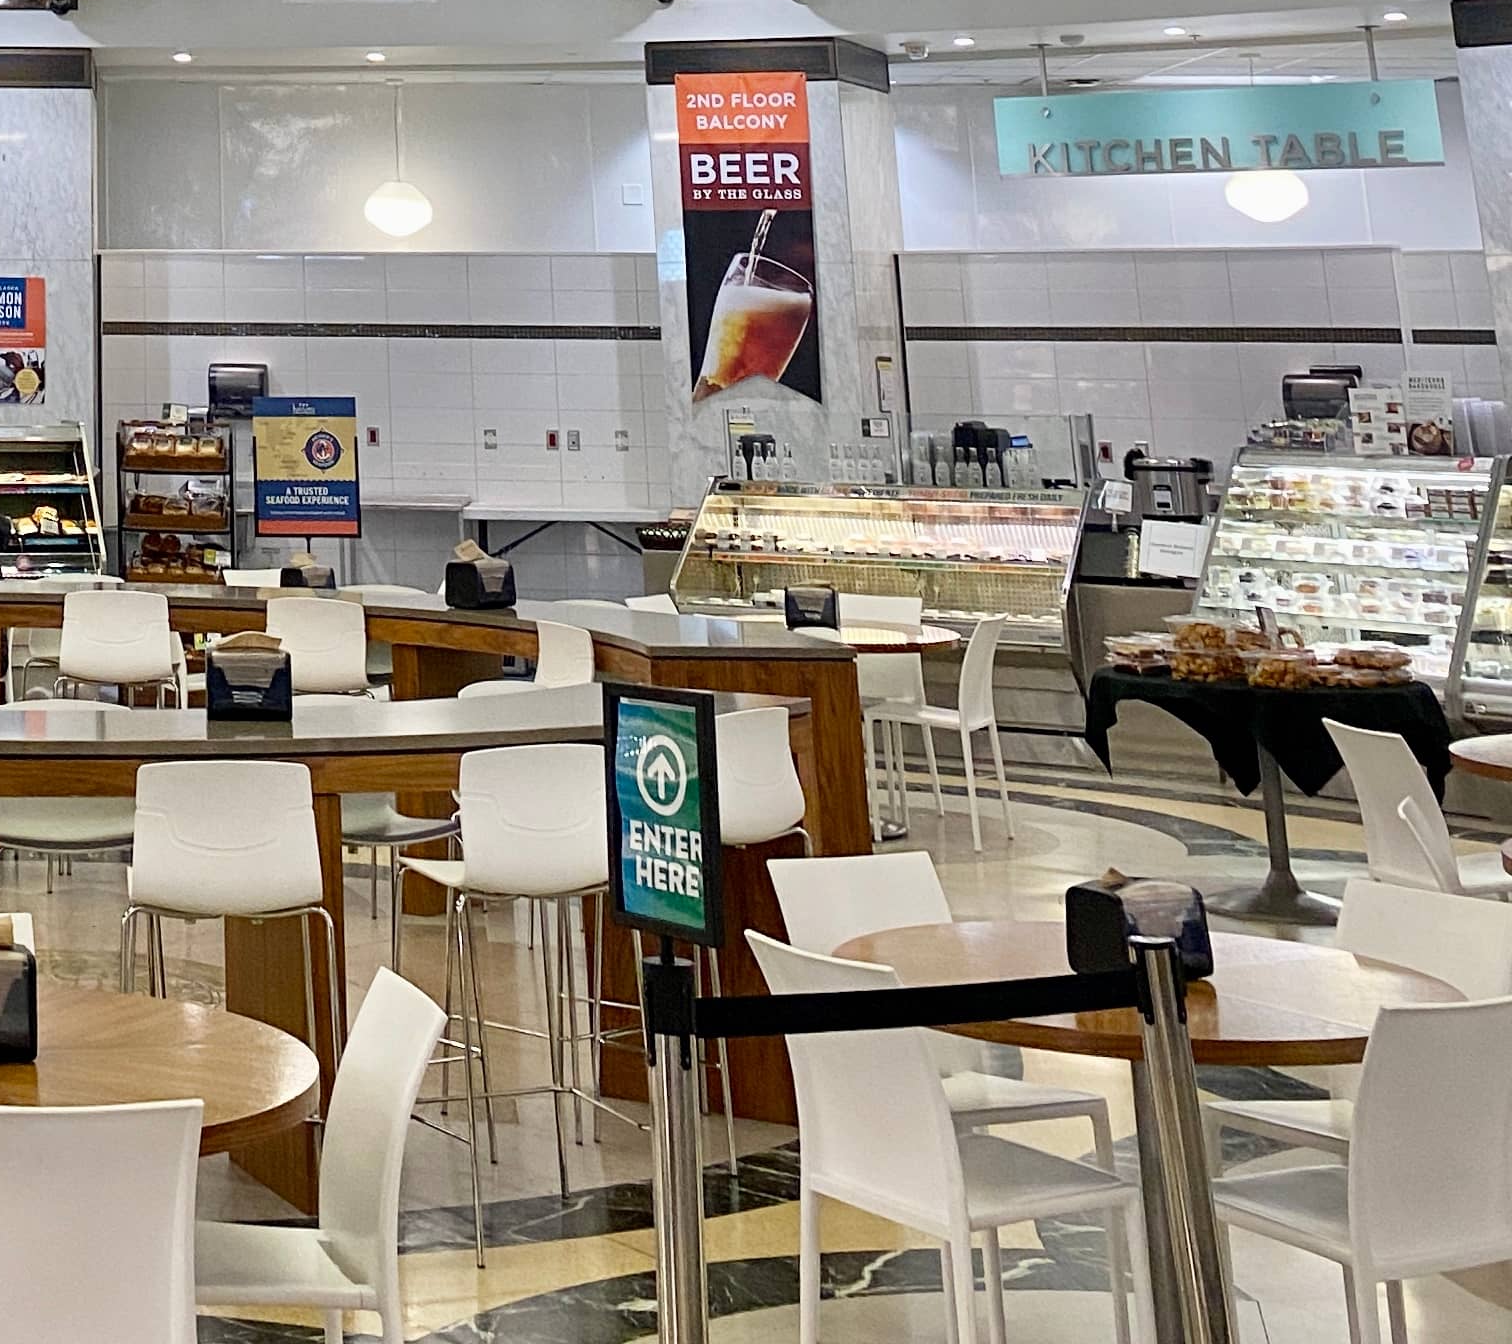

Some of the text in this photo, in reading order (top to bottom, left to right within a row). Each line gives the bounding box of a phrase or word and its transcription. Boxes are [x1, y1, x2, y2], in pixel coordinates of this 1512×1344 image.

[686, 92, 797, 109] 2ND FLOOR
[696, 114, 788, 130] BALCONY
[1027, 130, 1409, 175] KITCHEN TABLE
[690, 152, 801, 185] BEER
[693, 189, 802, 200] BY THE GLASS
[285, 486, 329, 496] A TRUSTED
[265, 495, 350, 506] SEAFOOD EXPERIENCE
[629, 819, 703, 863] ENTER
[636, 855, 701, 899] HERE
